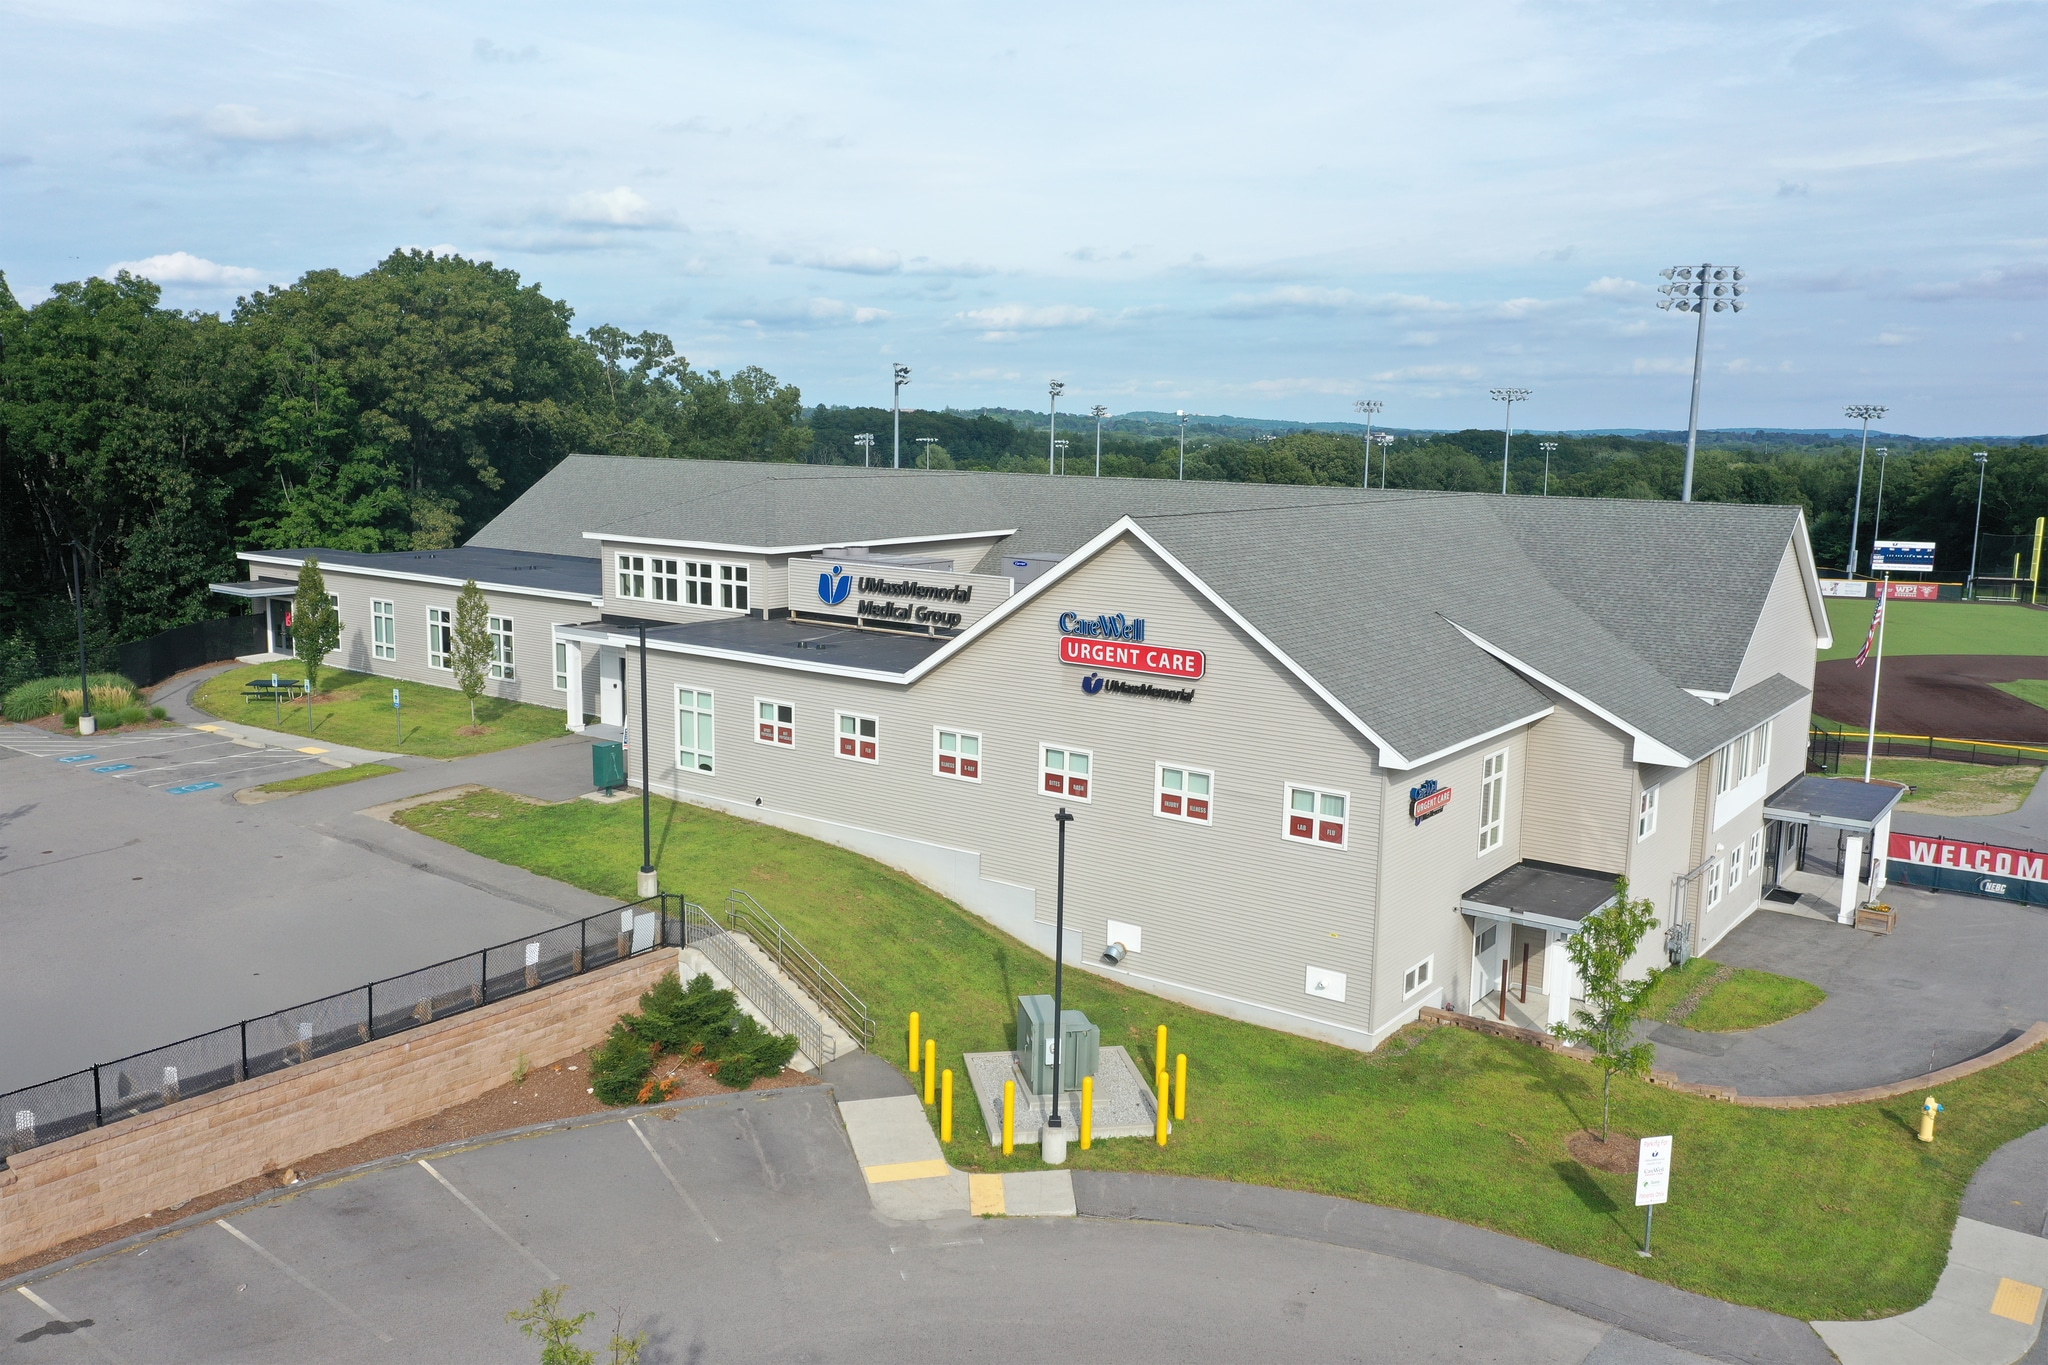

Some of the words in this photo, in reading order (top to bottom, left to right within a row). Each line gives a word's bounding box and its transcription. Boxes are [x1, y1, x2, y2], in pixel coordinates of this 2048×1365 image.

[858, 577, 972, 603] UMassMemorial
[1895, 585, 1917, 593] WPI
[858, 600, 913, 621] Medical
[915, 606, 961, 627] Group
[1059, 611, 1145, 641] CareWell
[1067, 642, 1140, 664] URGENT
[1146, 651, 1195, 671] CARE
[1105, 679, 1195, 702] UMassMemorial
[1049, 779, 1061, 787] BITES
[1164, 800, 1179, 809] INJURY
[1417, 797, 1437, 812] URGENT
[1437, 791, 1450, 804] CARE
[1189, 805, 1207, 814] ILLNESS
[1297, 823, 1307, 831] LAB
[1326, 829, 1336, 837] FLU
[1985, 882, 2007, 892] NEBC
